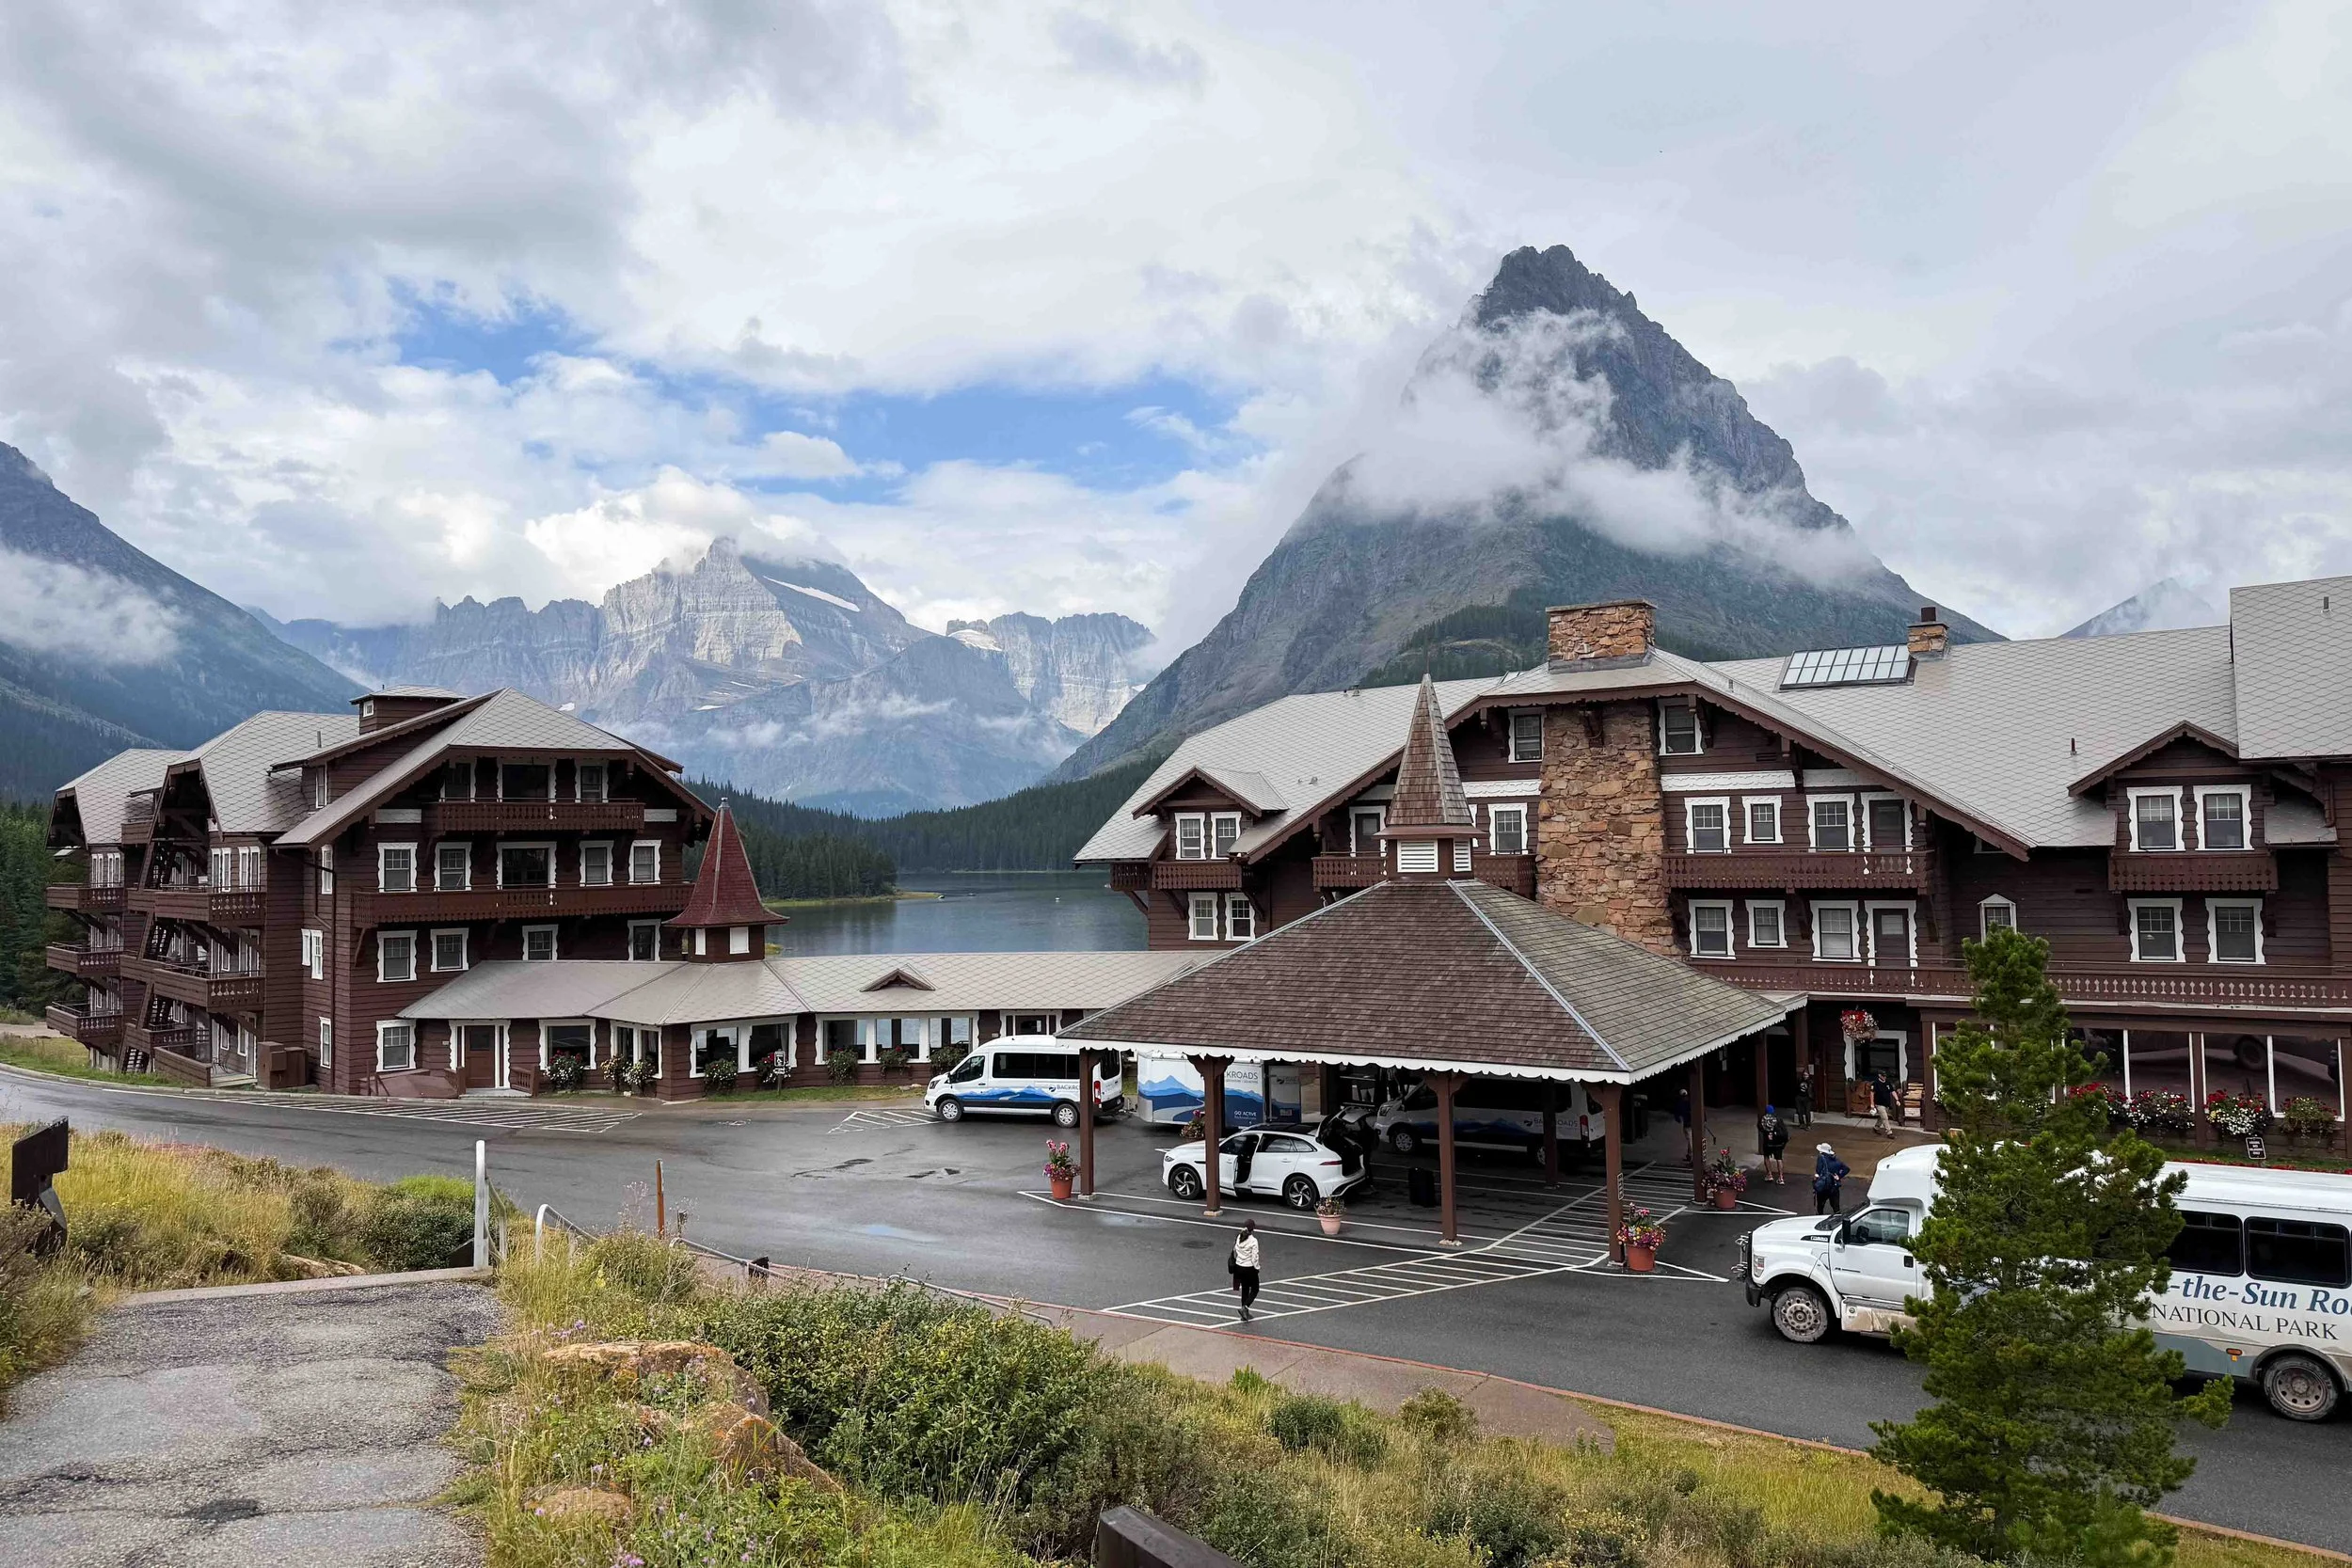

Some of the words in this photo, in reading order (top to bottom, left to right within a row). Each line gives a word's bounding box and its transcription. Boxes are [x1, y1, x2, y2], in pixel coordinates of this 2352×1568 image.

[1227, 1070, 1259, 1080] KROADS
[2166, 1275, 2297, 1309] -the-Sun
[2306, 1289, 2352, 1315] Ro
[2152, 1303, 2270, 1332] NATIONAL
[2275, 1317, 2340, 1340] PARK
